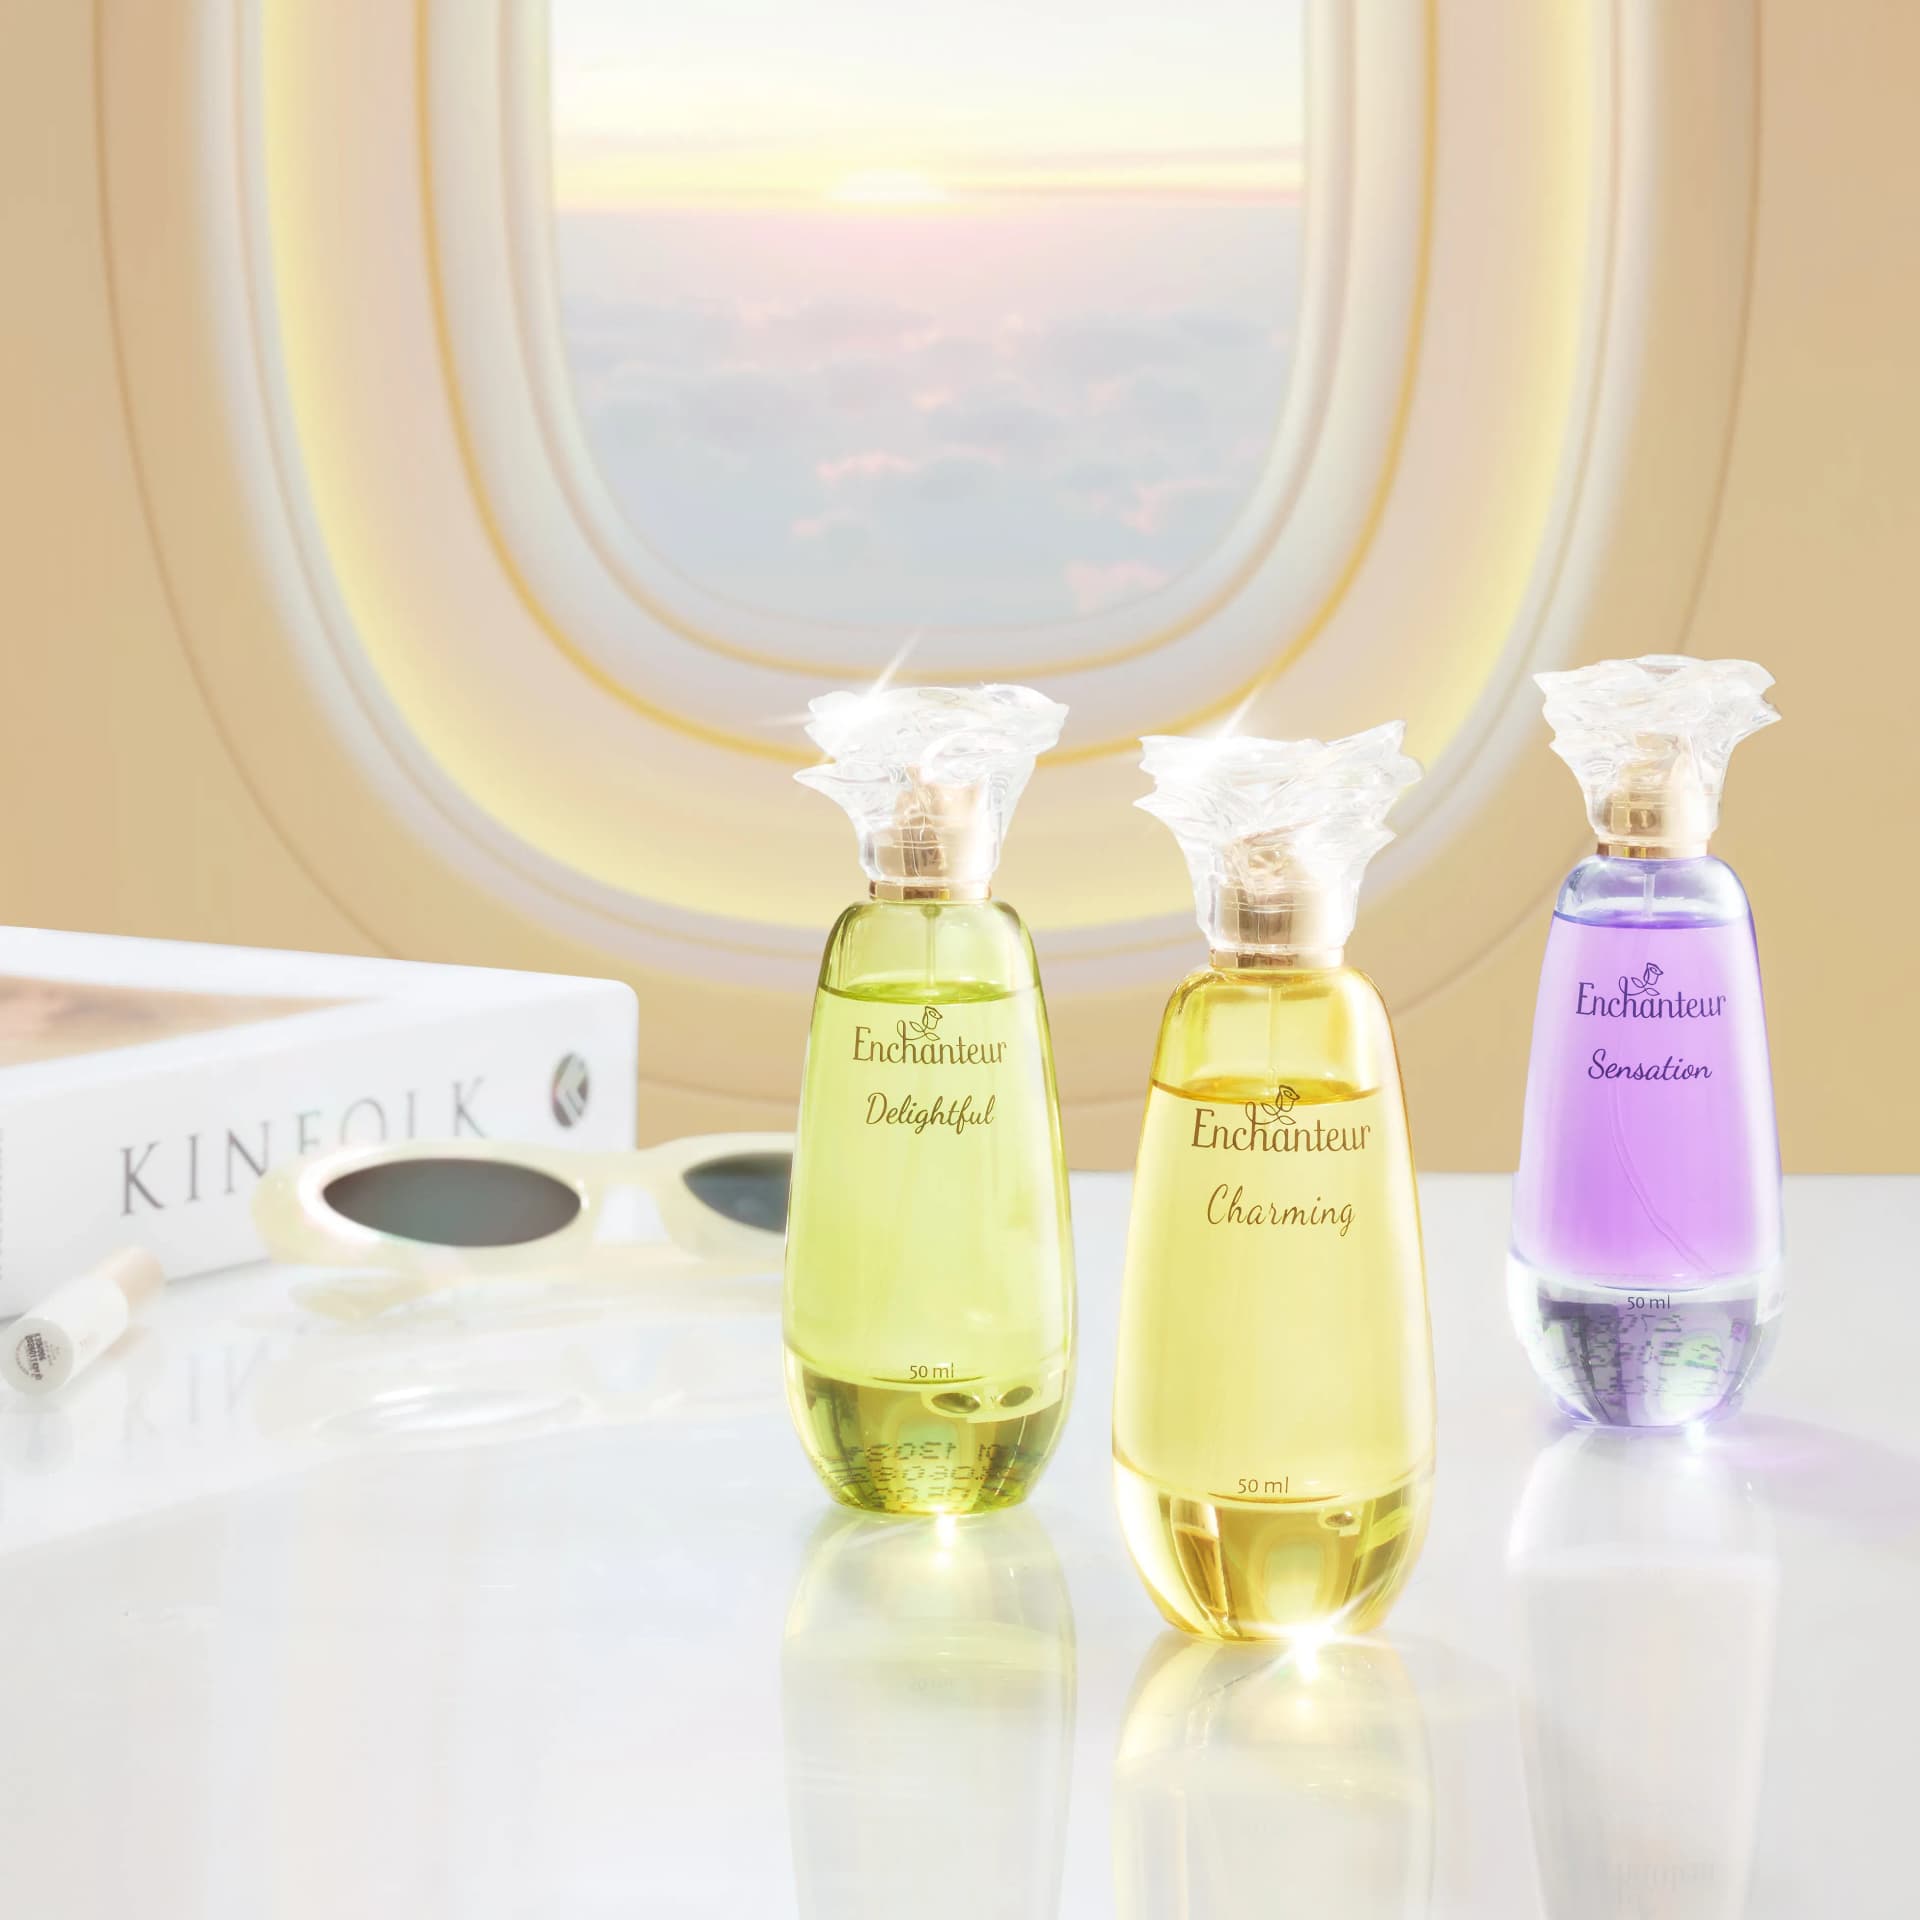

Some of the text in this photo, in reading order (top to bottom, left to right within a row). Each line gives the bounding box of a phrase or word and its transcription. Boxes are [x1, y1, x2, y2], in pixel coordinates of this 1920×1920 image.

[1575, 976, 1727, 1019] Enchanteur
[852, 1020, 1007, 1064] Enchanteur
[1587, 1048, 1713, 1081] Sensation
[865, 1092, 997, 1135] Delightful
[1191, 1101, 1371, 1152] Enchanteur
[1206, 1183, 1356, 1237] Charming
[1626, 1295, 1671, 1310] 50 ml
[909, 1362, 955, 1380] 50 ml
[1237, 1476, 1289, 1494] 50 ml
